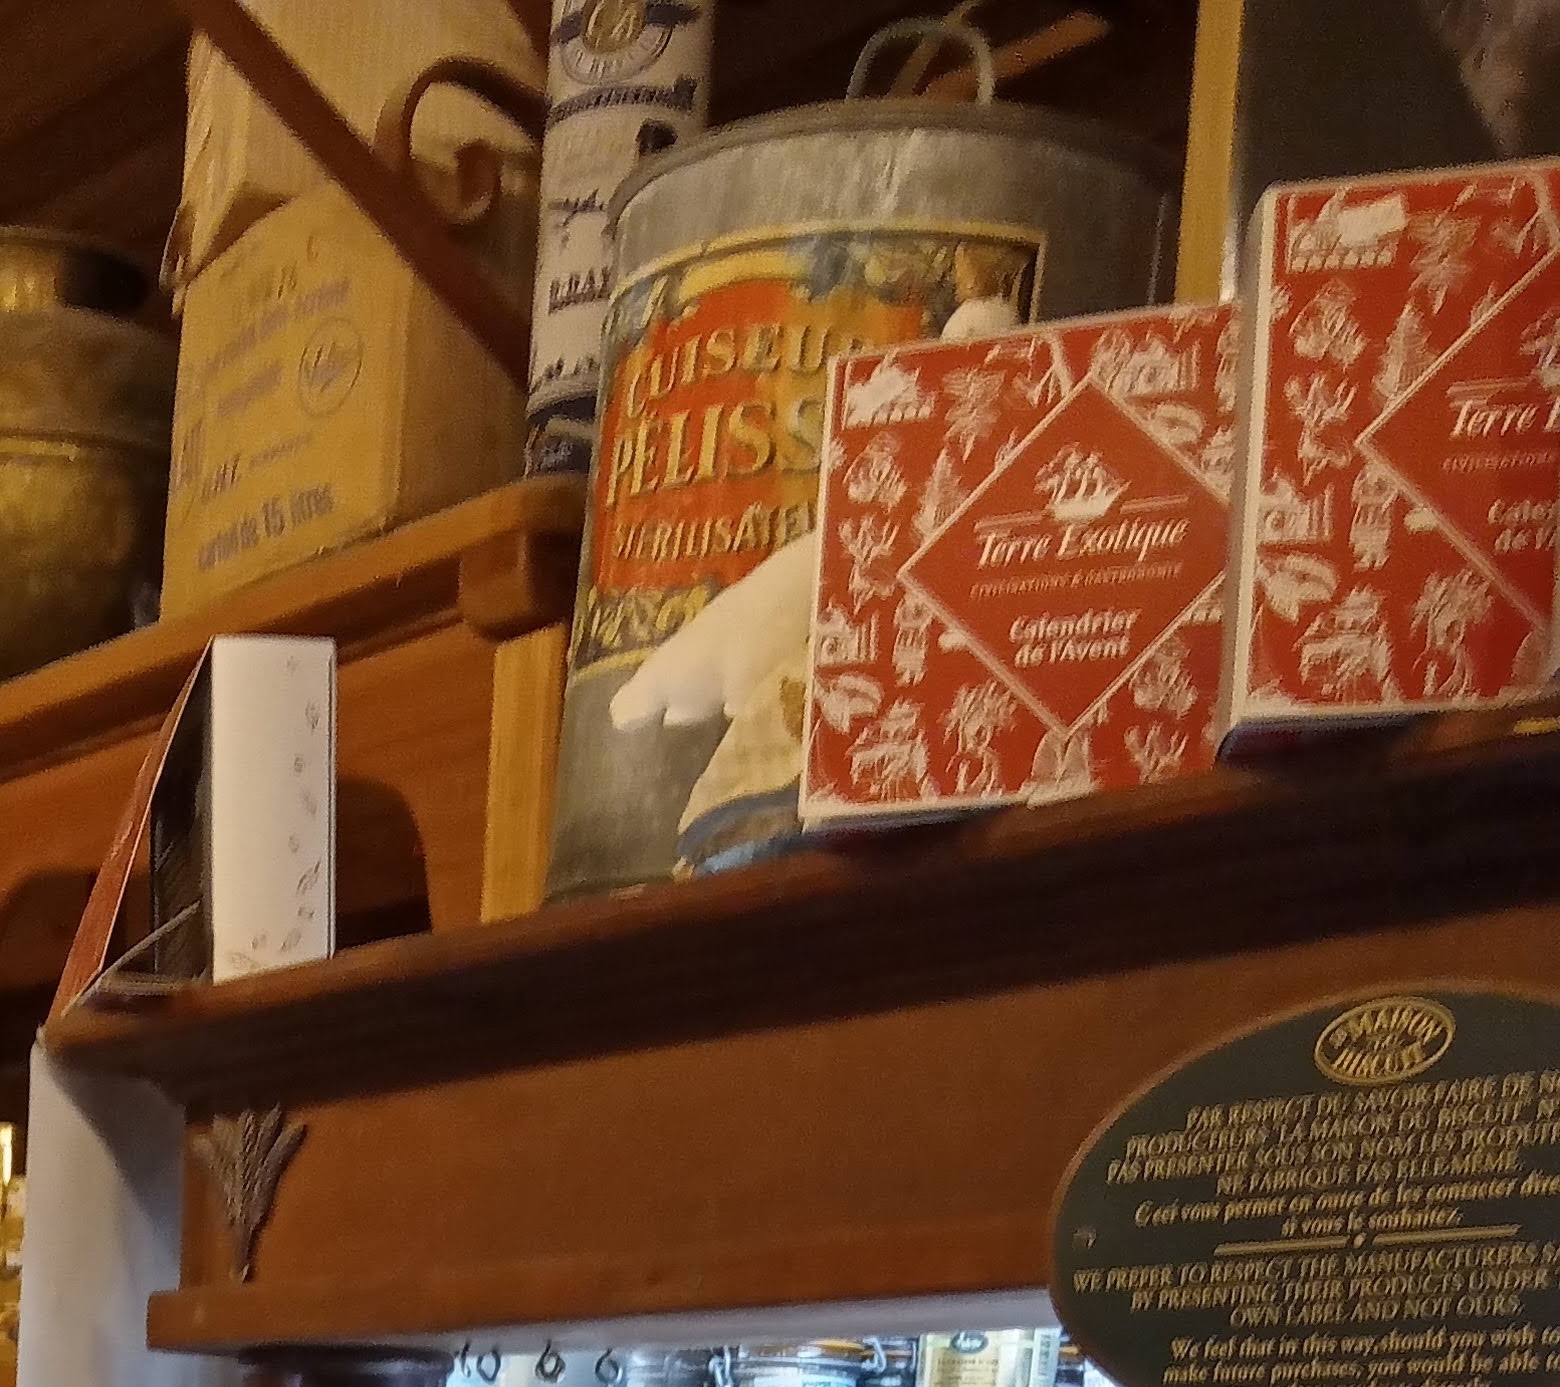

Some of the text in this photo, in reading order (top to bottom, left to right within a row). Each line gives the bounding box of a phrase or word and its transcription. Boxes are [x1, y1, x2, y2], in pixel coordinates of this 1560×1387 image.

[627, 323, 832, 418] CUISEU
[976, 517, 1190, 570] Terre Exotique
[1009, 608, 1141, 643] Calendrier
[1228, 1096, 1312, 1124] RESPECT
[1309, 1113, 1390, 1143] MAISON
[1249, 1163, 1351, 1193] FABRIQUE
[1073, 1268, 1104, 1294] WE
[1106, 1263, 1176, 1292] PREFER
[1179, 1262, 1209, 1287] TO
[1210, 1256, 1293, 1286] RESPECT
[1157, 1280, 1279, 1311] PRESENTING
[1347, 1271, 1466, 1300] PRODUCTS
[1230, 1305, 1282, 1329] OWN
[1350, 1299, 1400, 1324] AND
[1403, 1294, 1453, 1320] NOT
[1170, 1336, 1200, 1361] We
[1449, 1329, 1487, 1352] you
[1489, 1321, 1537, 1349] wish
[1162, 1362, 1210, 1386] make
[1407, 1351, 1467, 1376] would
[1470, 1350, 1495, 1374] be
[1498, 1349, 1540, 1375] able
